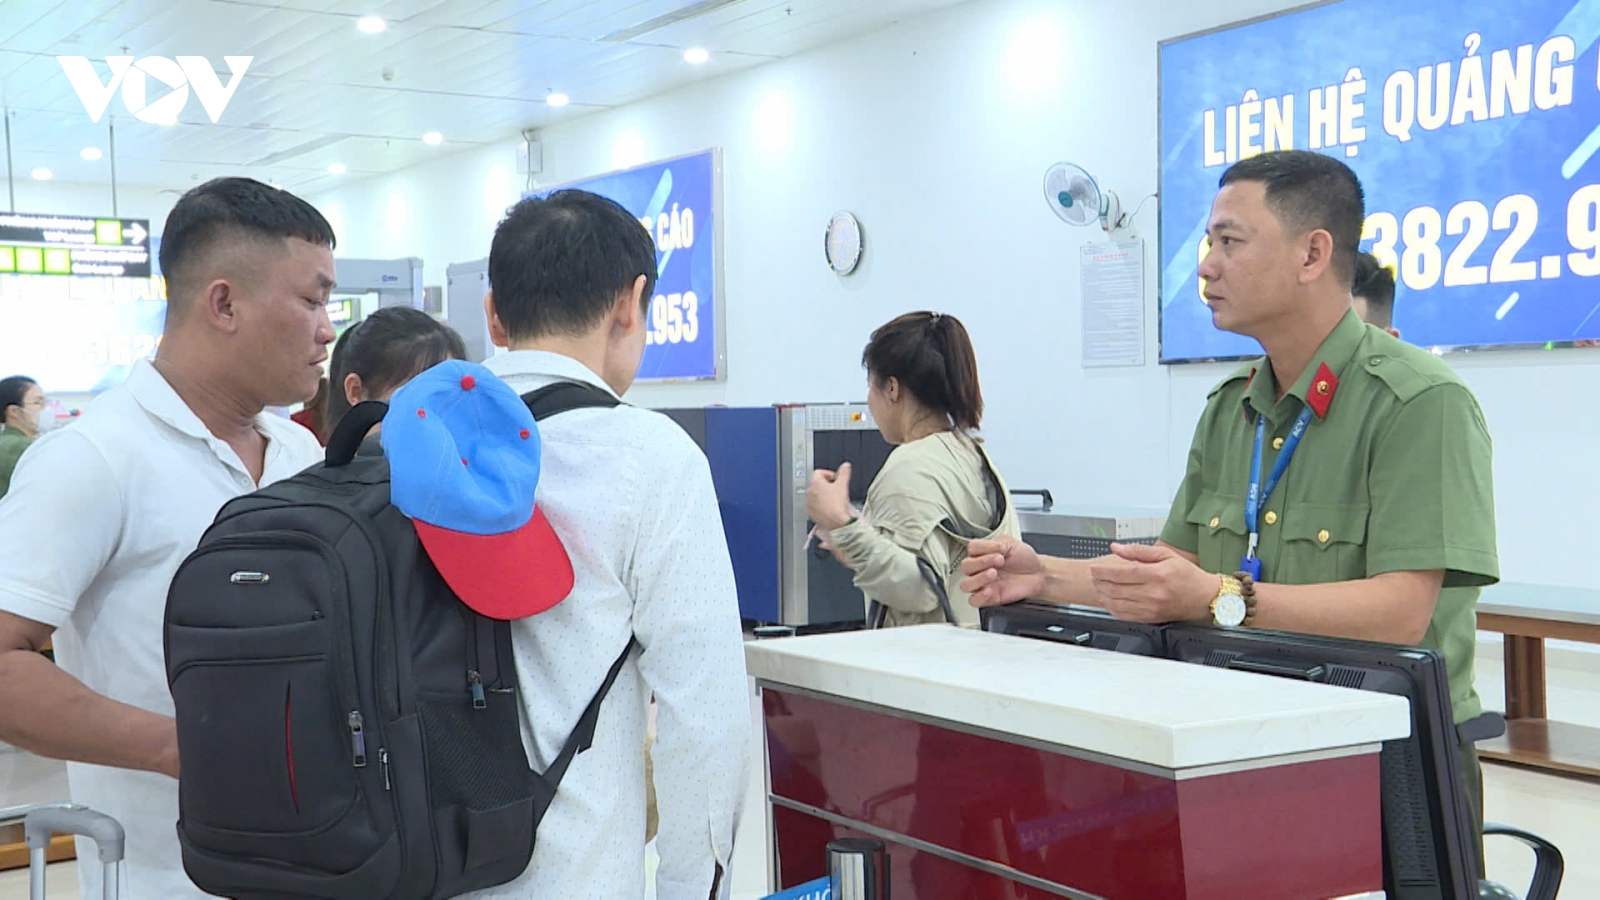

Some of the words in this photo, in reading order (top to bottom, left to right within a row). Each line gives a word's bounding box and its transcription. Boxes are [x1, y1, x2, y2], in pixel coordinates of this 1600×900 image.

[1204, 89, 1294, 167] LIÊN
[1309, 67, 1366, 158] HỆ
[1383, 33, 1575, 142] QUẢNG
[657, 202, 694, 252] CÁO
